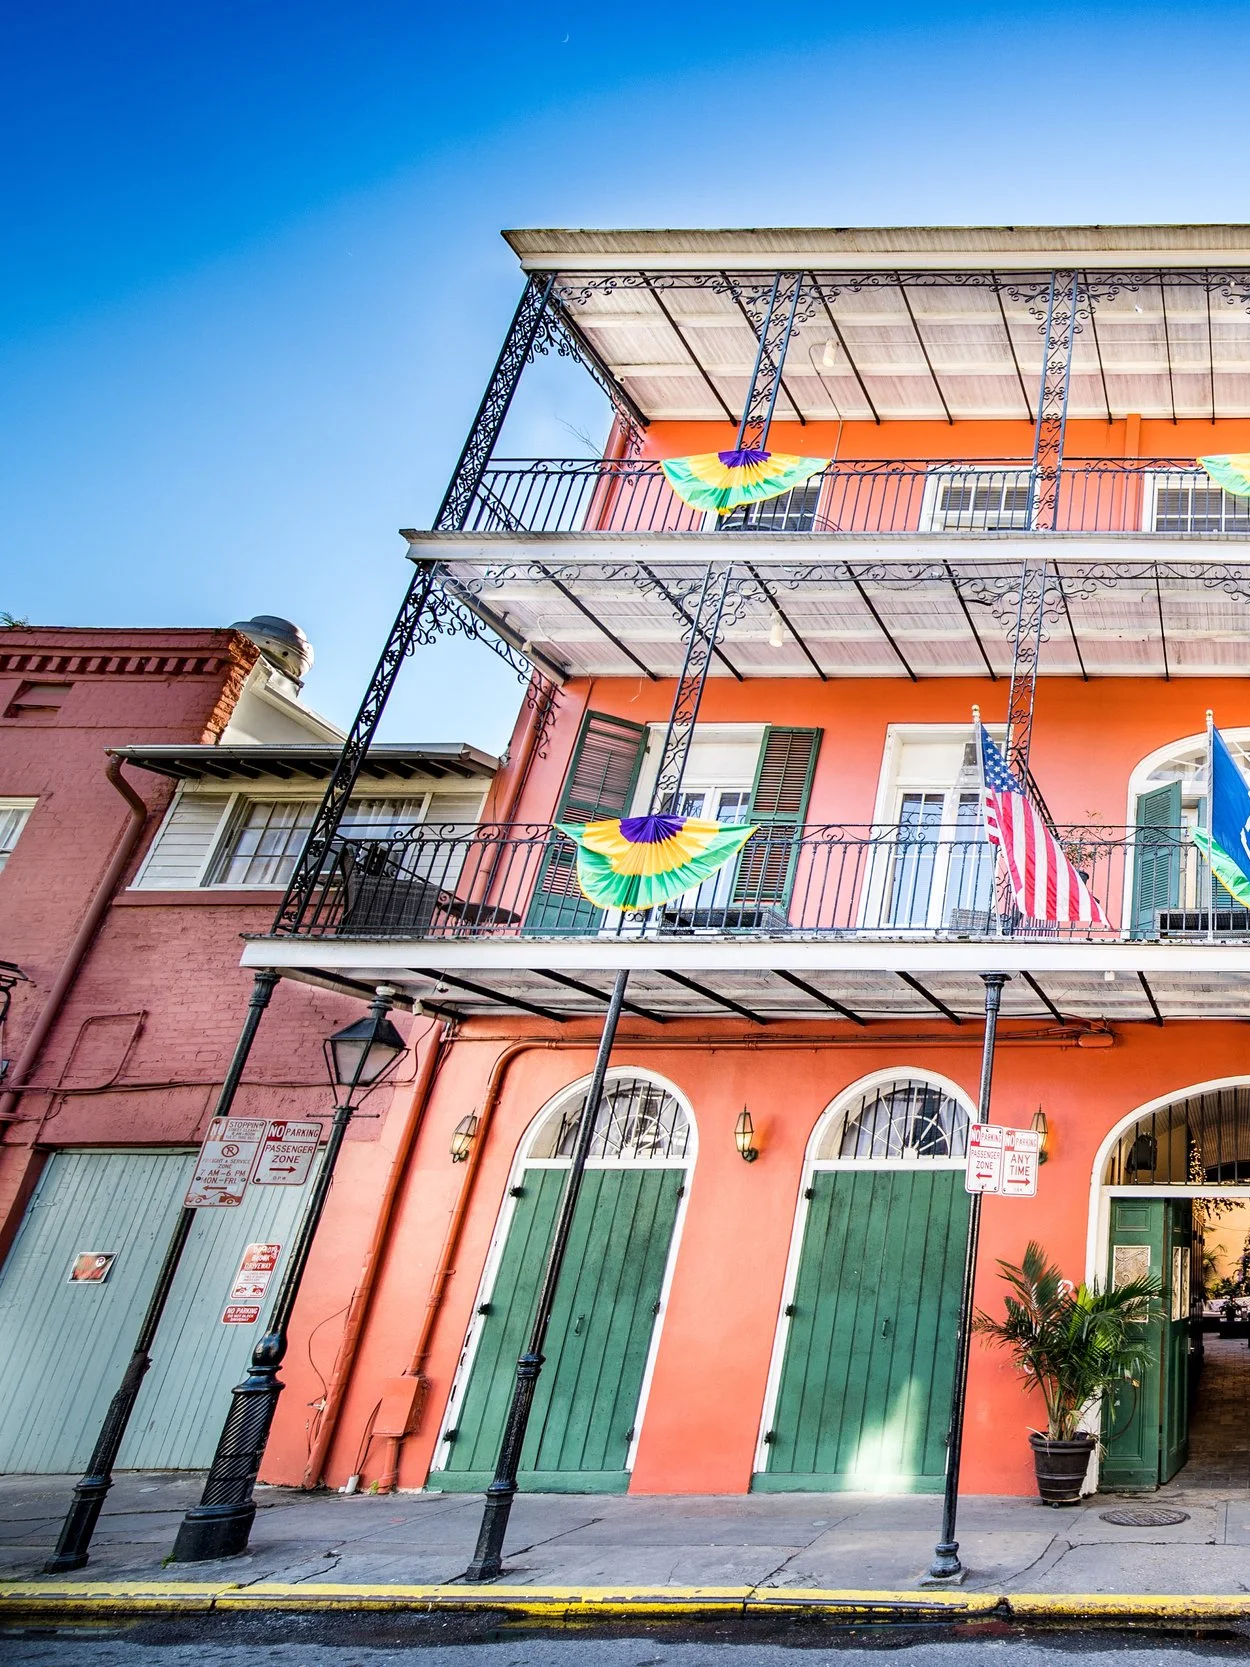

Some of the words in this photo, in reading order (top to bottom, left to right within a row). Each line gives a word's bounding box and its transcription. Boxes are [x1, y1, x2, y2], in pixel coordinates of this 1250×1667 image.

[268, 1125, 285, 1137] NO
[286, 1128, 319, 1138] PARKING
[970, 1128, 981, 1142] NO
[981, 1133, 1001, 1143] PARKING
[1005, 1134, 1015, 1148] NO
[1016, 1138, 1036, 1148] PARKING
[265, 1145, 314, 1154] PASSENGER
[971, 1149, 1000, 1160] PASSENGER
[272, 1155, 301, 1164] ZONE
[976, 1160, 993, 1170] ZONE
[1010, 1154, 1031, 1165] ANY
[1010, 1165, 1031, 1176] TIME
